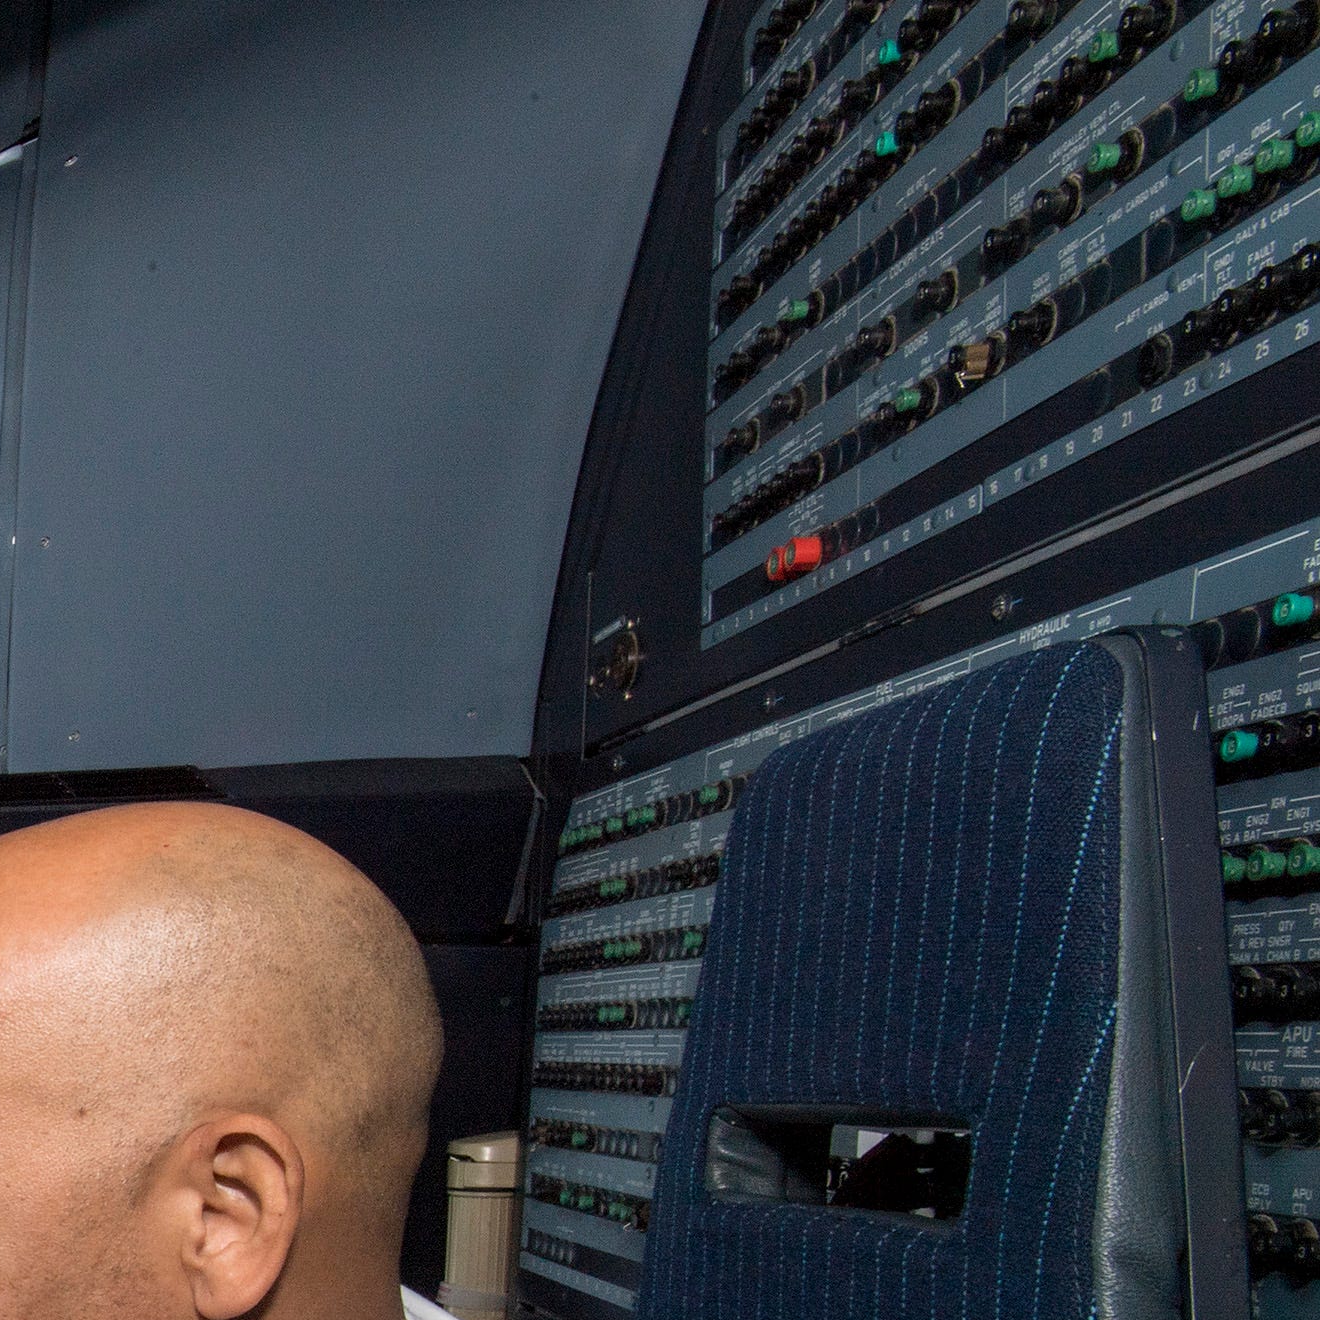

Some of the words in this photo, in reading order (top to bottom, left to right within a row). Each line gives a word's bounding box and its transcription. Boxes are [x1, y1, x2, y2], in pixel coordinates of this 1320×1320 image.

[1234, 222, 1259, 244] GALY
[1270, 204, 1291, 221] CAB
[1247, 240, 1276, 266] FAULT
[1294, 319, 1310, 341] 26
[1254, 340, 1270, 361] 25
[1218, 360, 1232, 380] 24
[1183, 378, 1197, 397] 23
[1150, 394, 1163, 413] 22
[1120, 410, 1133, 428] 21
[1091, 426, 1104, 442] 20
[1065, 440, 1075, 456] 19
[1019, 614, 1072, 646] HYDRAULIC
[874, 680, 894, 698] FUEL
[1222, 684, 1246, 700] ENG2
[1258, 688, 1283, 706] ENG2
[1250, 702, 1288, 721] FADECB
[1270, 796, 1287, 810] IGN
[1246, 813, 1271, 828] ENG2
[1286, 806, 1312, 822] ENG1
[1243, 830, 1262, 843] BAT
[1232, 924, 1262, 936] PRESS
[1278, 920, 1296, 933] QTY
[1248, 936, 1264, 948] REV
[1267, 934, 1292, 948] SNSR
[1266, 950, 1292, 962] CHAN
[1282, 1026, 1314, 1044] APU
[1286, 1046, 1309, 1058] FIRE
[1244, 1060, 1276, 1072] VALVE
[1260, 1076, 1286, 1088] STBY
[1252, 1183, 1270, 1196] ECB
[1292, 1188, 1313, 1200] APU
[1292, 1204, 1310, 1216] CTL
